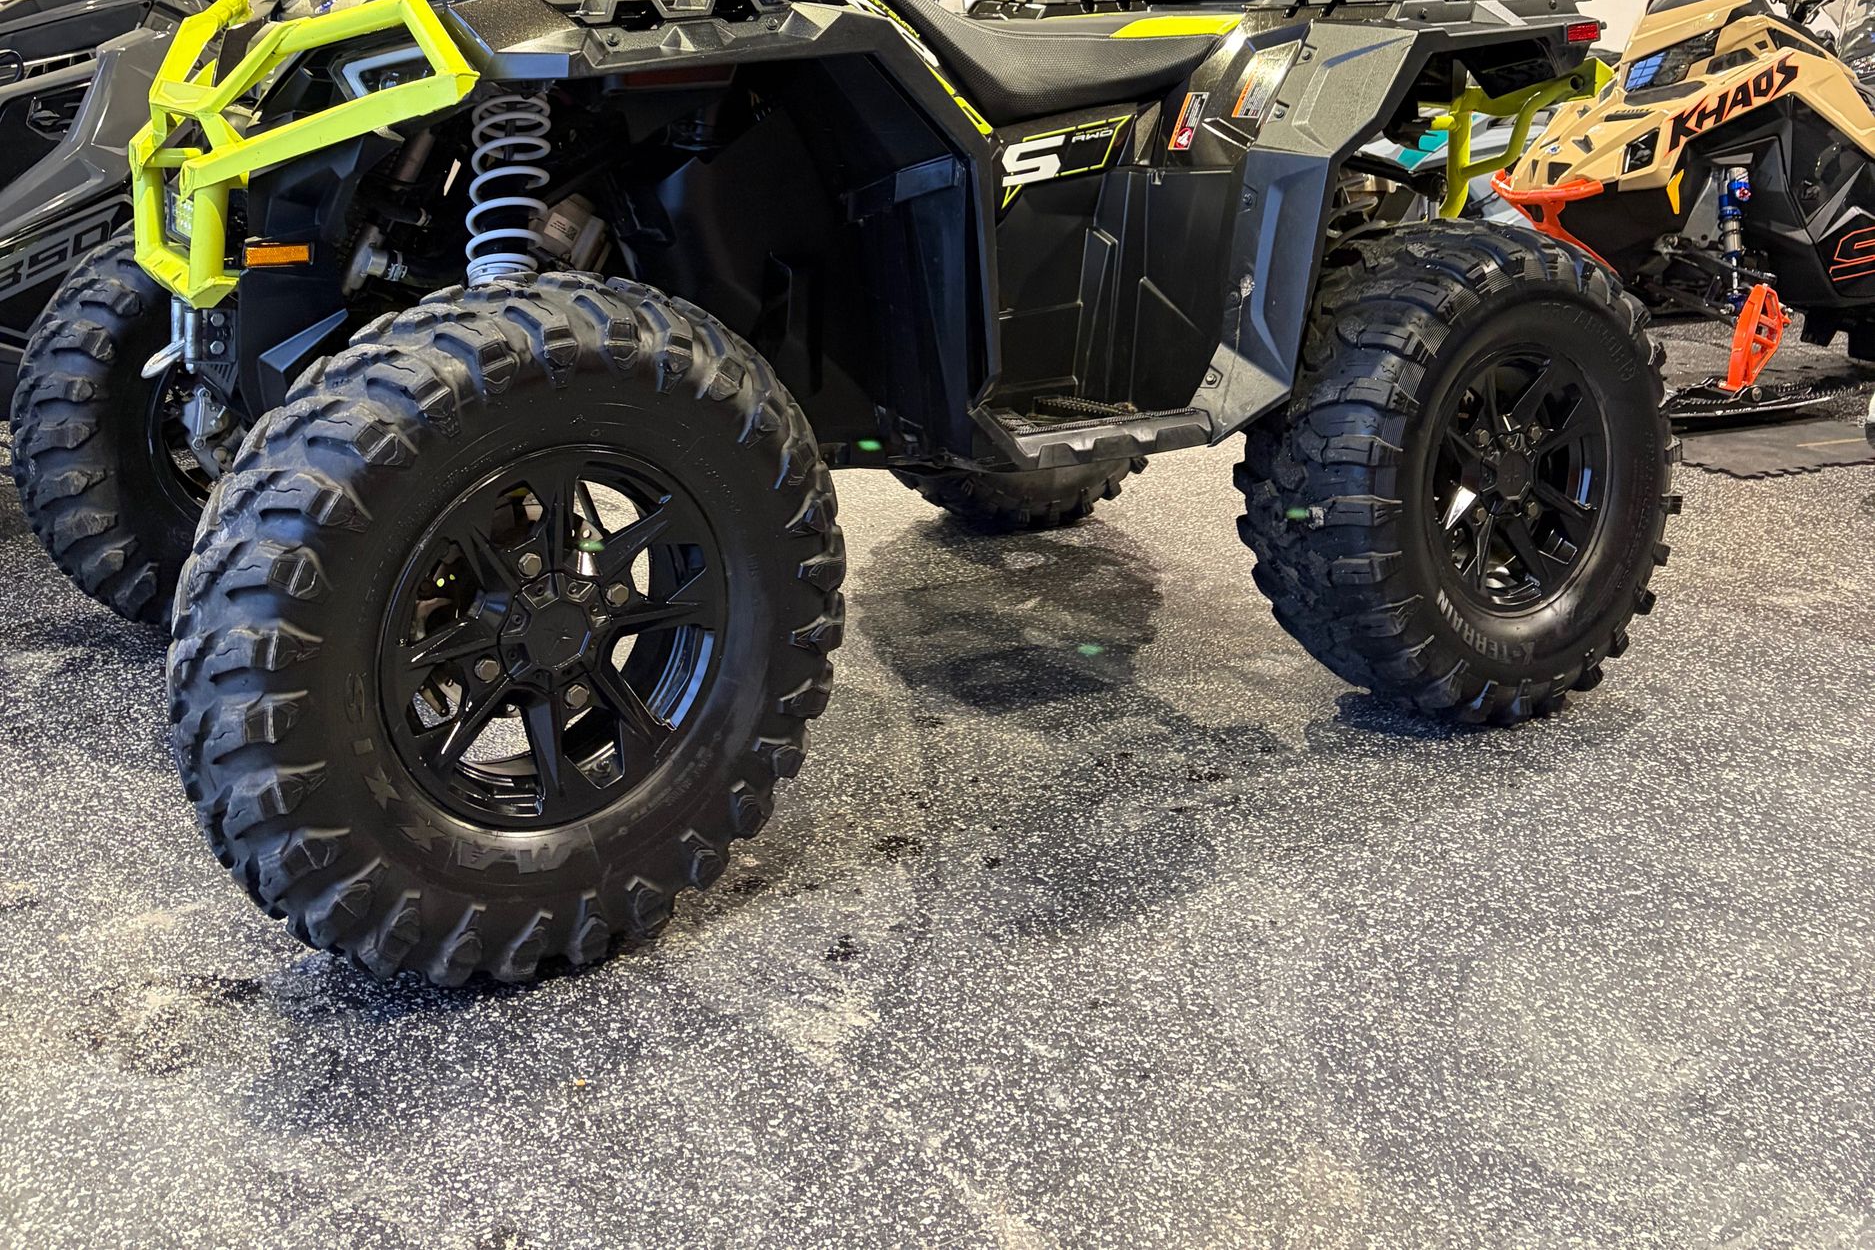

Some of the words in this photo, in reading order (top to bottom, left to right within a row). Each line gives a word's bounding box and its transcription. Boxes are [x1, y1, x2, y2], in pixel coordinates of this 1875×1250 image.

[1666, 53, 1799, 155] KHAOS
[1001, 135, 1066, 187] S
[1071, 129, 1114, 143] AWD
